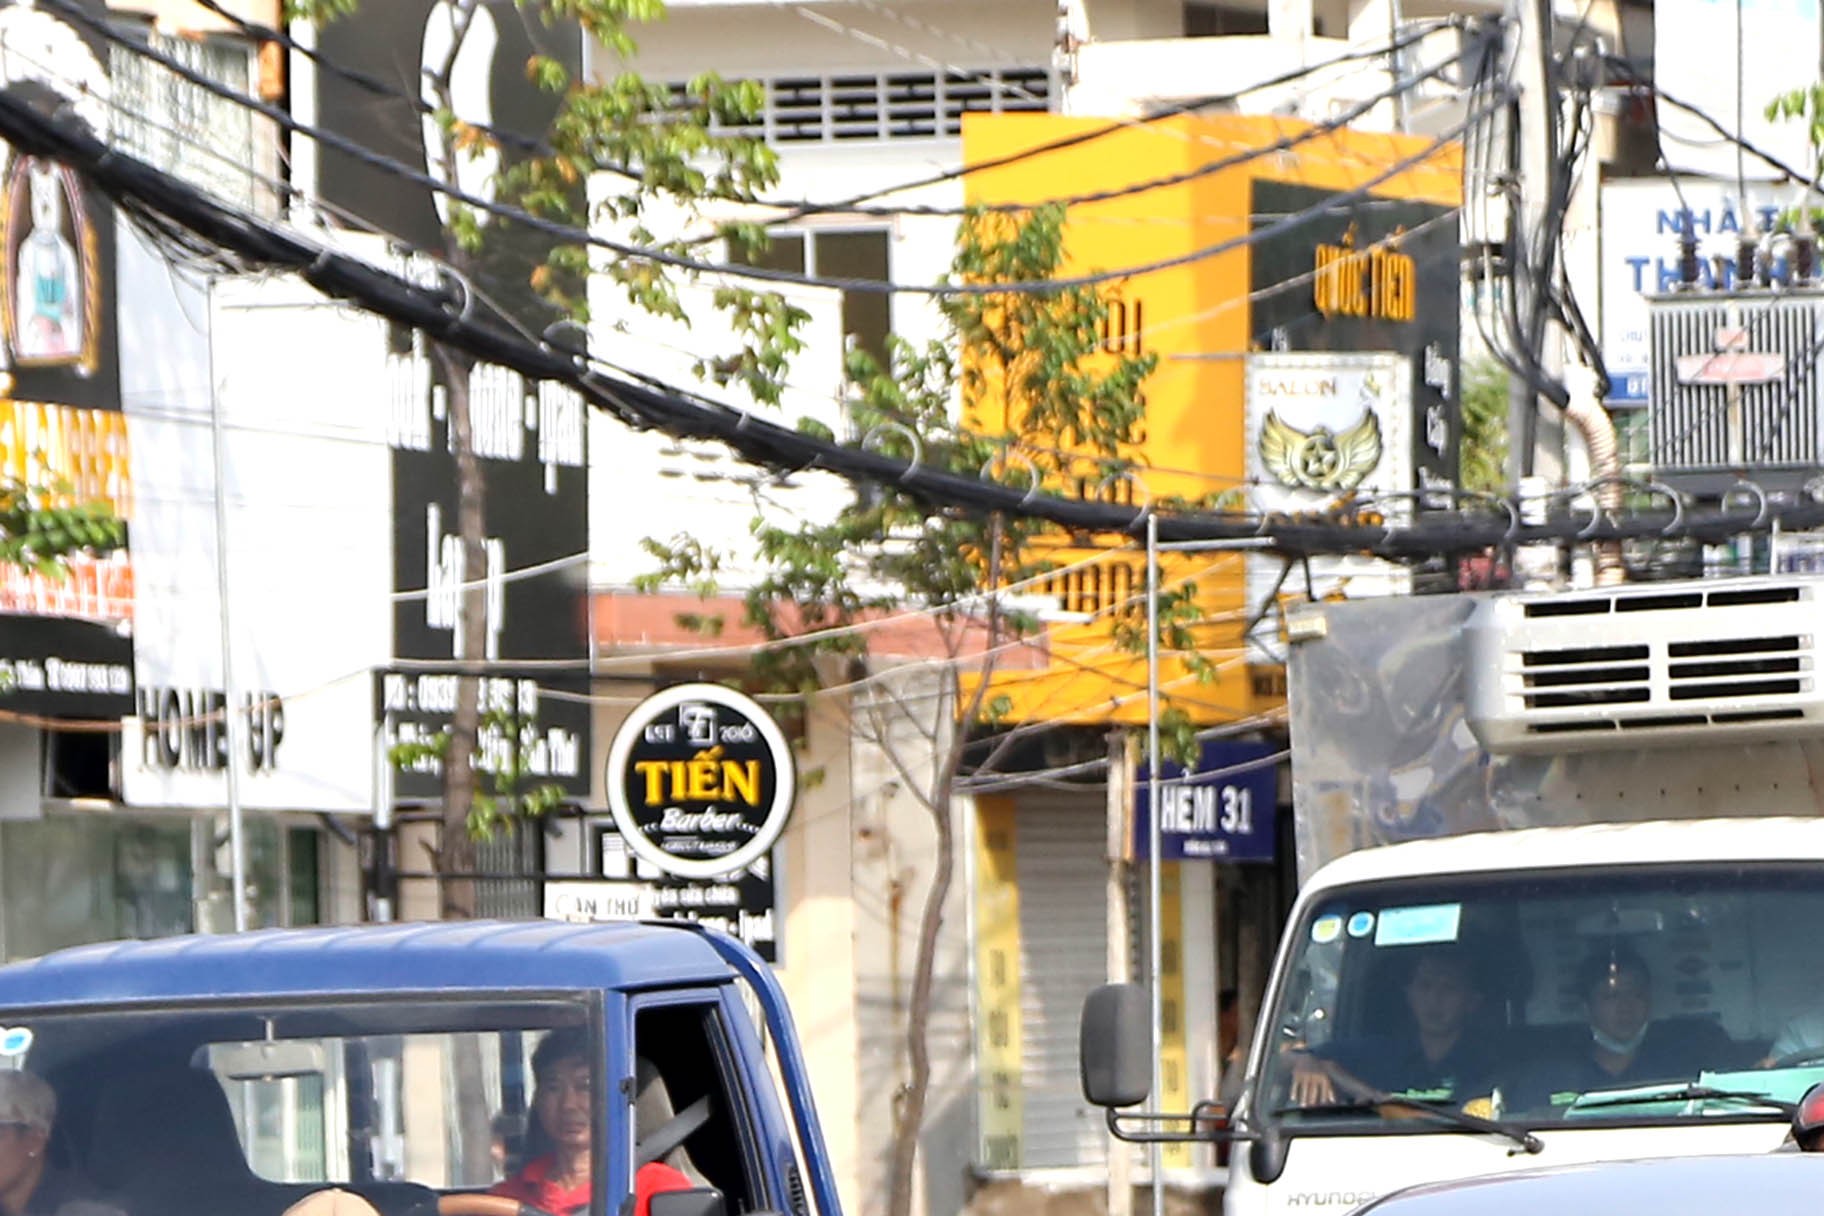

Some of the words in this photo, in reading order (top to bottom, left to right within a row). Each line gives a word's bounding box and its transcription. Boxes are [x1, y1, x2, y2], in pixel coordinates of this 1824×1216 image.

[634, 744, 763, 808] TIẾN
[659, 804, 748, 834] Barber
[1219, 783, 1254, 834] 31
